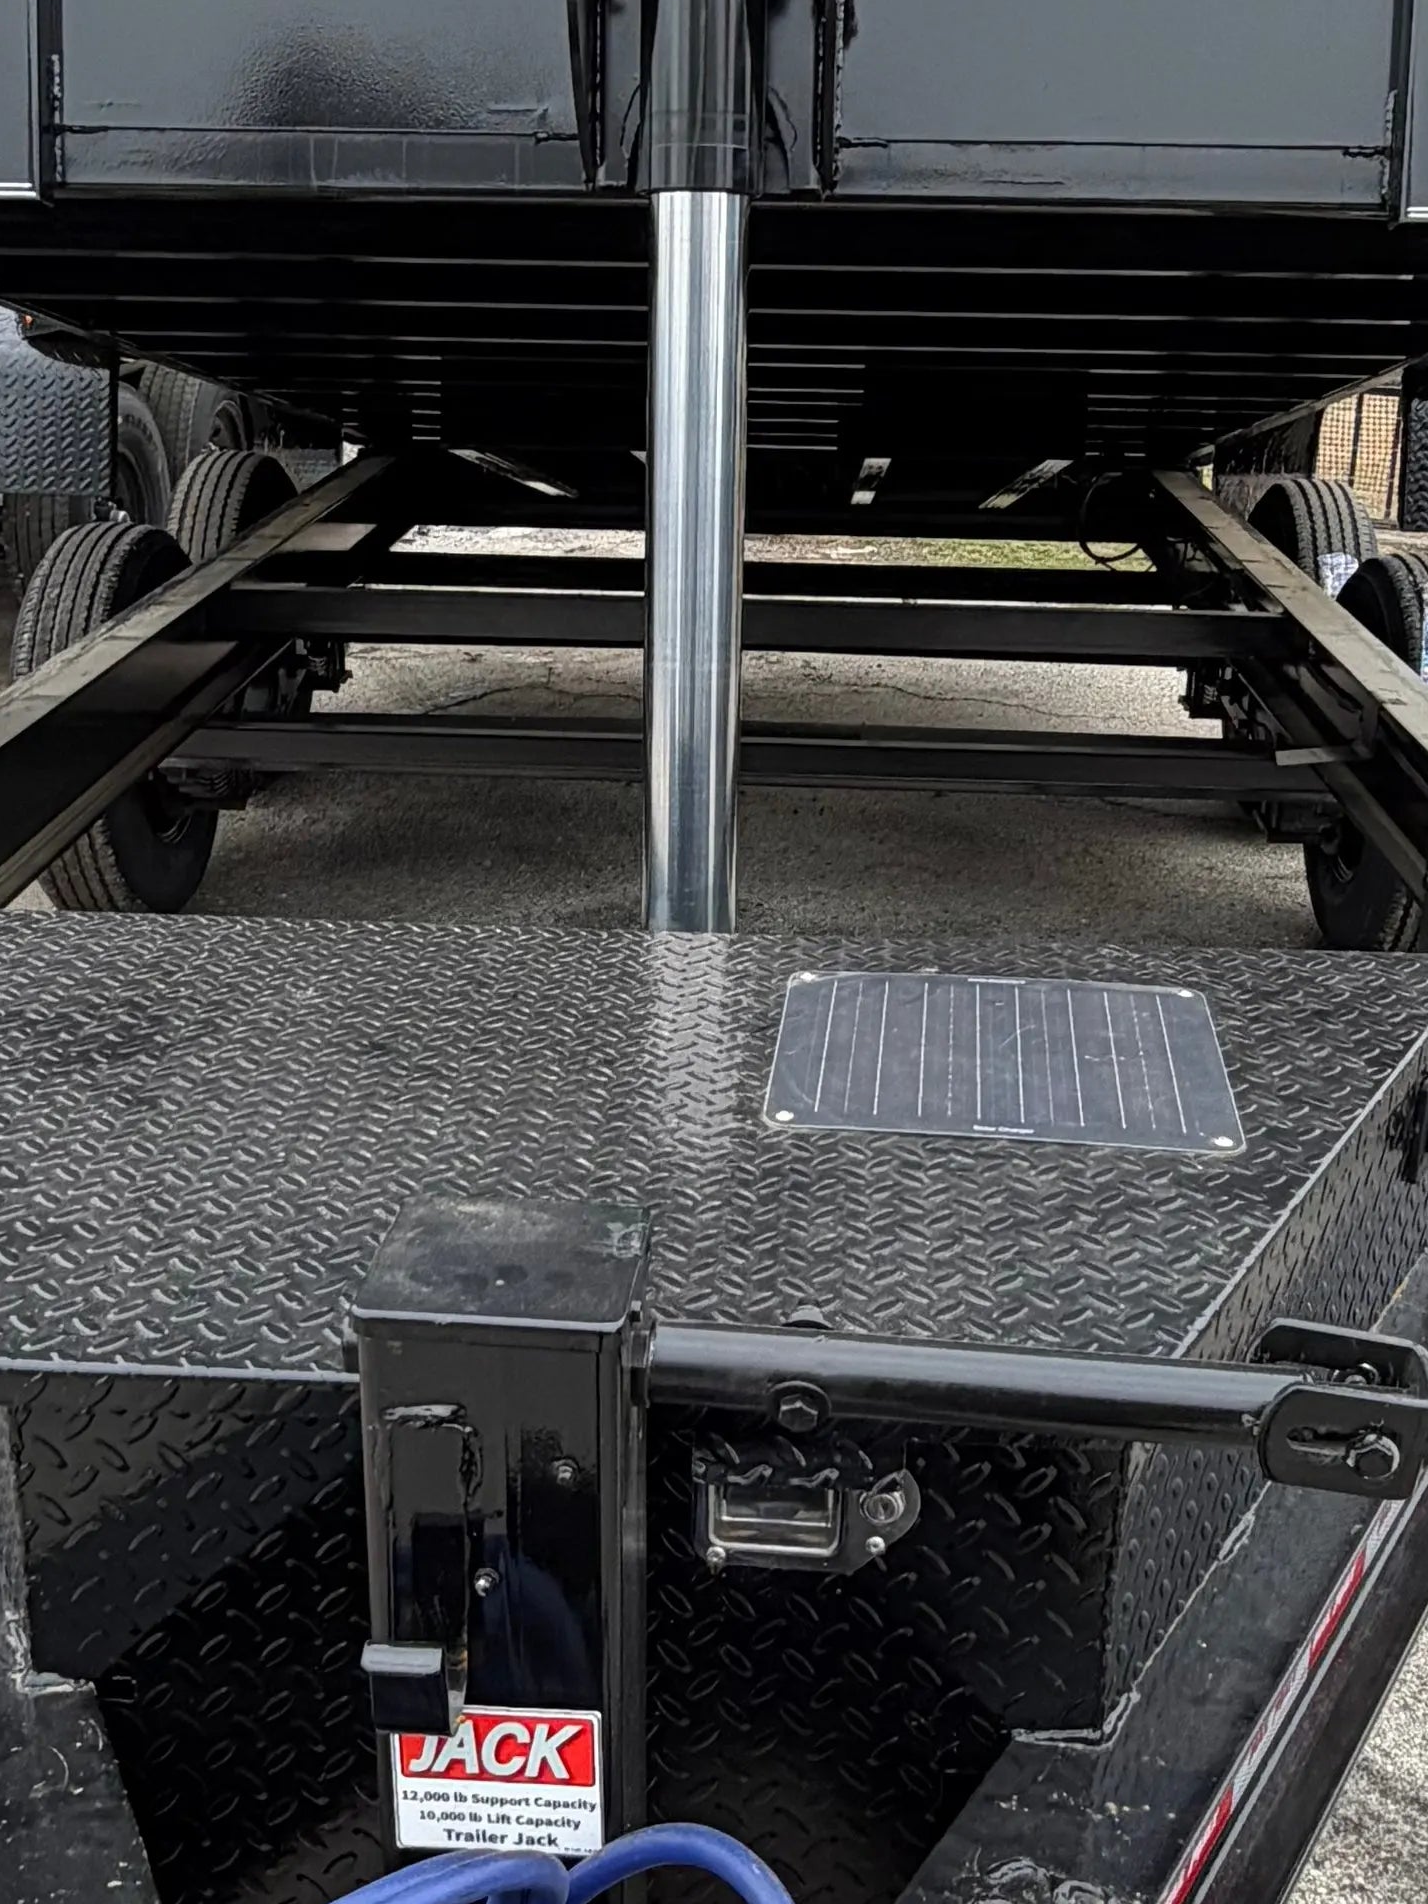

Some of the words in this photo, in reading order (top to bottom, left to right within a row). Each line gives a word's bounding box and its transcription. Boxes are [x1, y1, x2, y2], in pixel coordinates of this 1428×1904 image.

[408, 1718, 584, 1780] JACK
[401, 1789, 451, 1805] 12,000
[453, 1791, 468, 1803] lb
[471, 1793, 531, 1810] Support
[534, 1796, 598, 1813] Capacity
[419, 1809, 466, 1824] 10,000
[468, 1811, 483, 1823] lb
[487, 1813, 512, 1826] Lift
[515, 1815, 582, 1832] Capacity
[443, 1828, 509, 1845] Trailer
[512, 1831, 559, 1847] Jack
